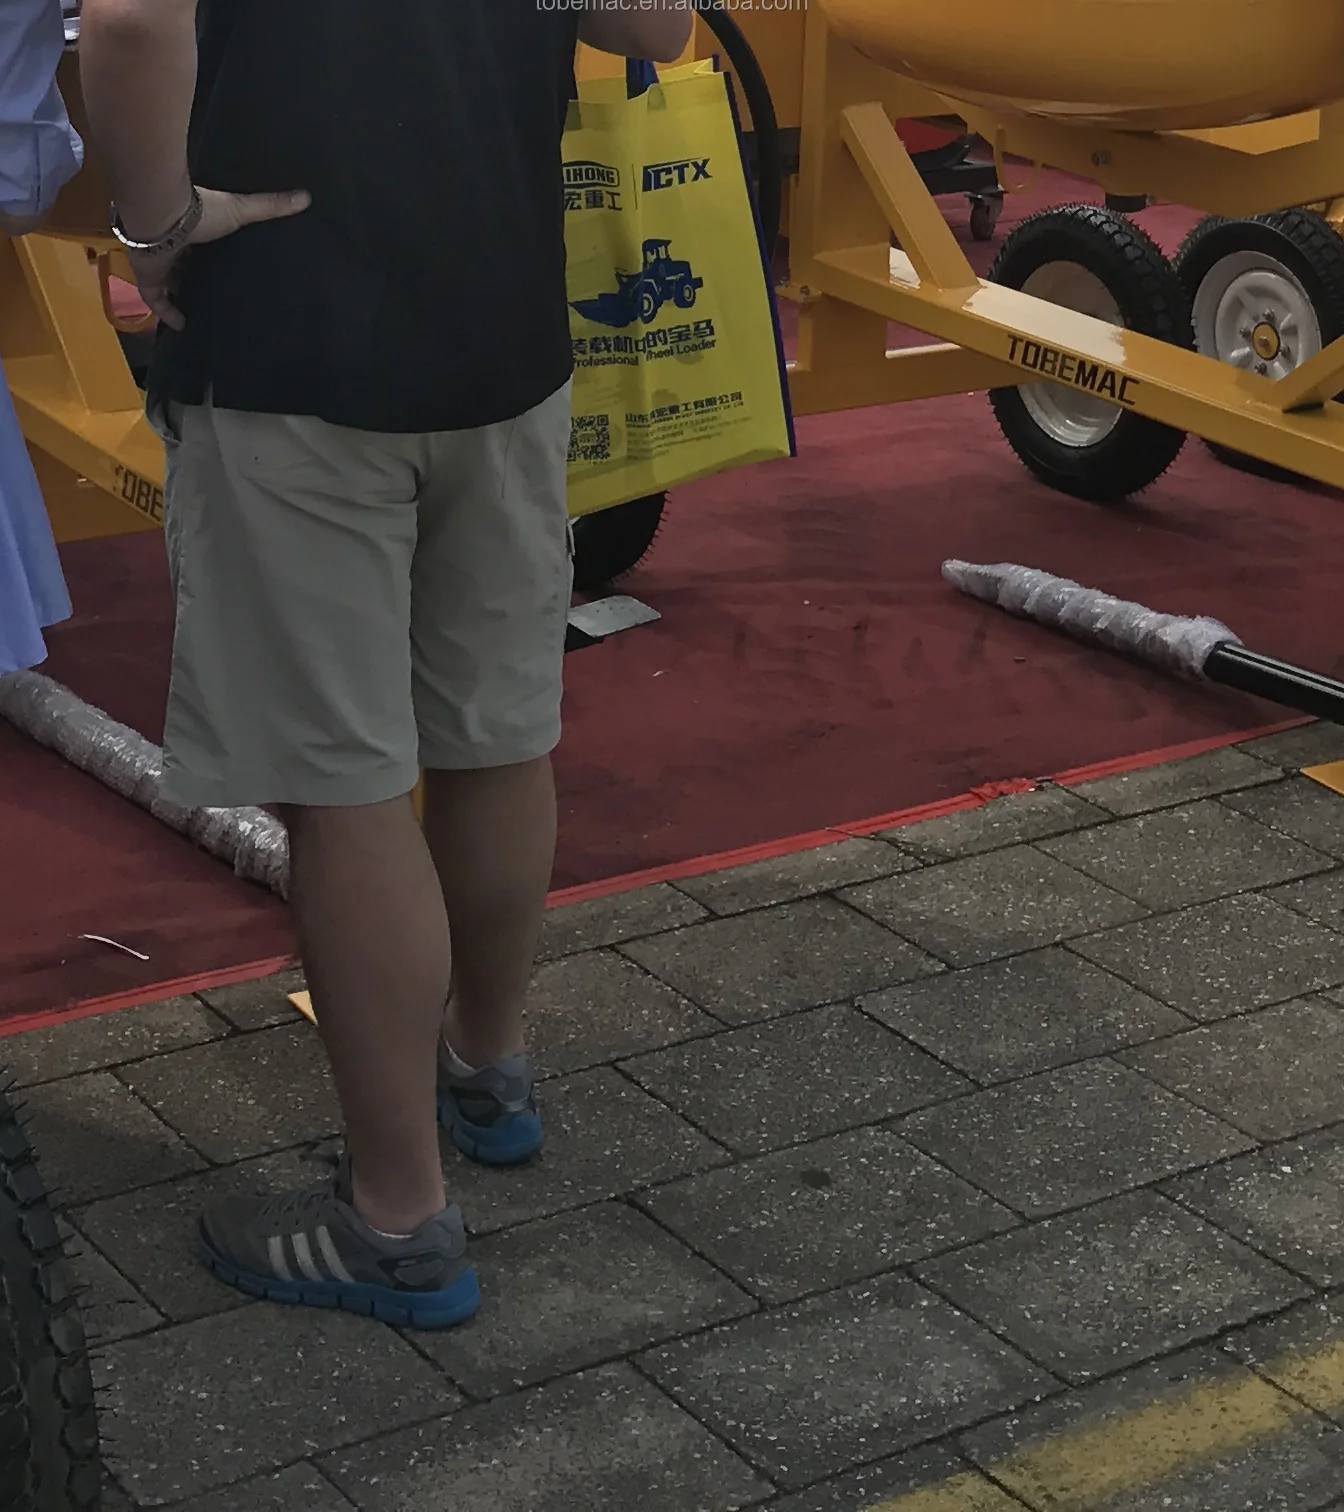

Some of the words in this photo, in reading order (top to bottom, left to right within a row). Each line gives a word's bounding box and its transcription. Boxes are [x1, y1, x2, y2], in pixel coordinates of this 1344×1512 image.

[564, 189, 623, 211] 宏重工
[572, 354, 639, 368] rofessional
[676, 338, 717, 355] Loader
[1007, 333, 1140, 406] TOBEMAC
